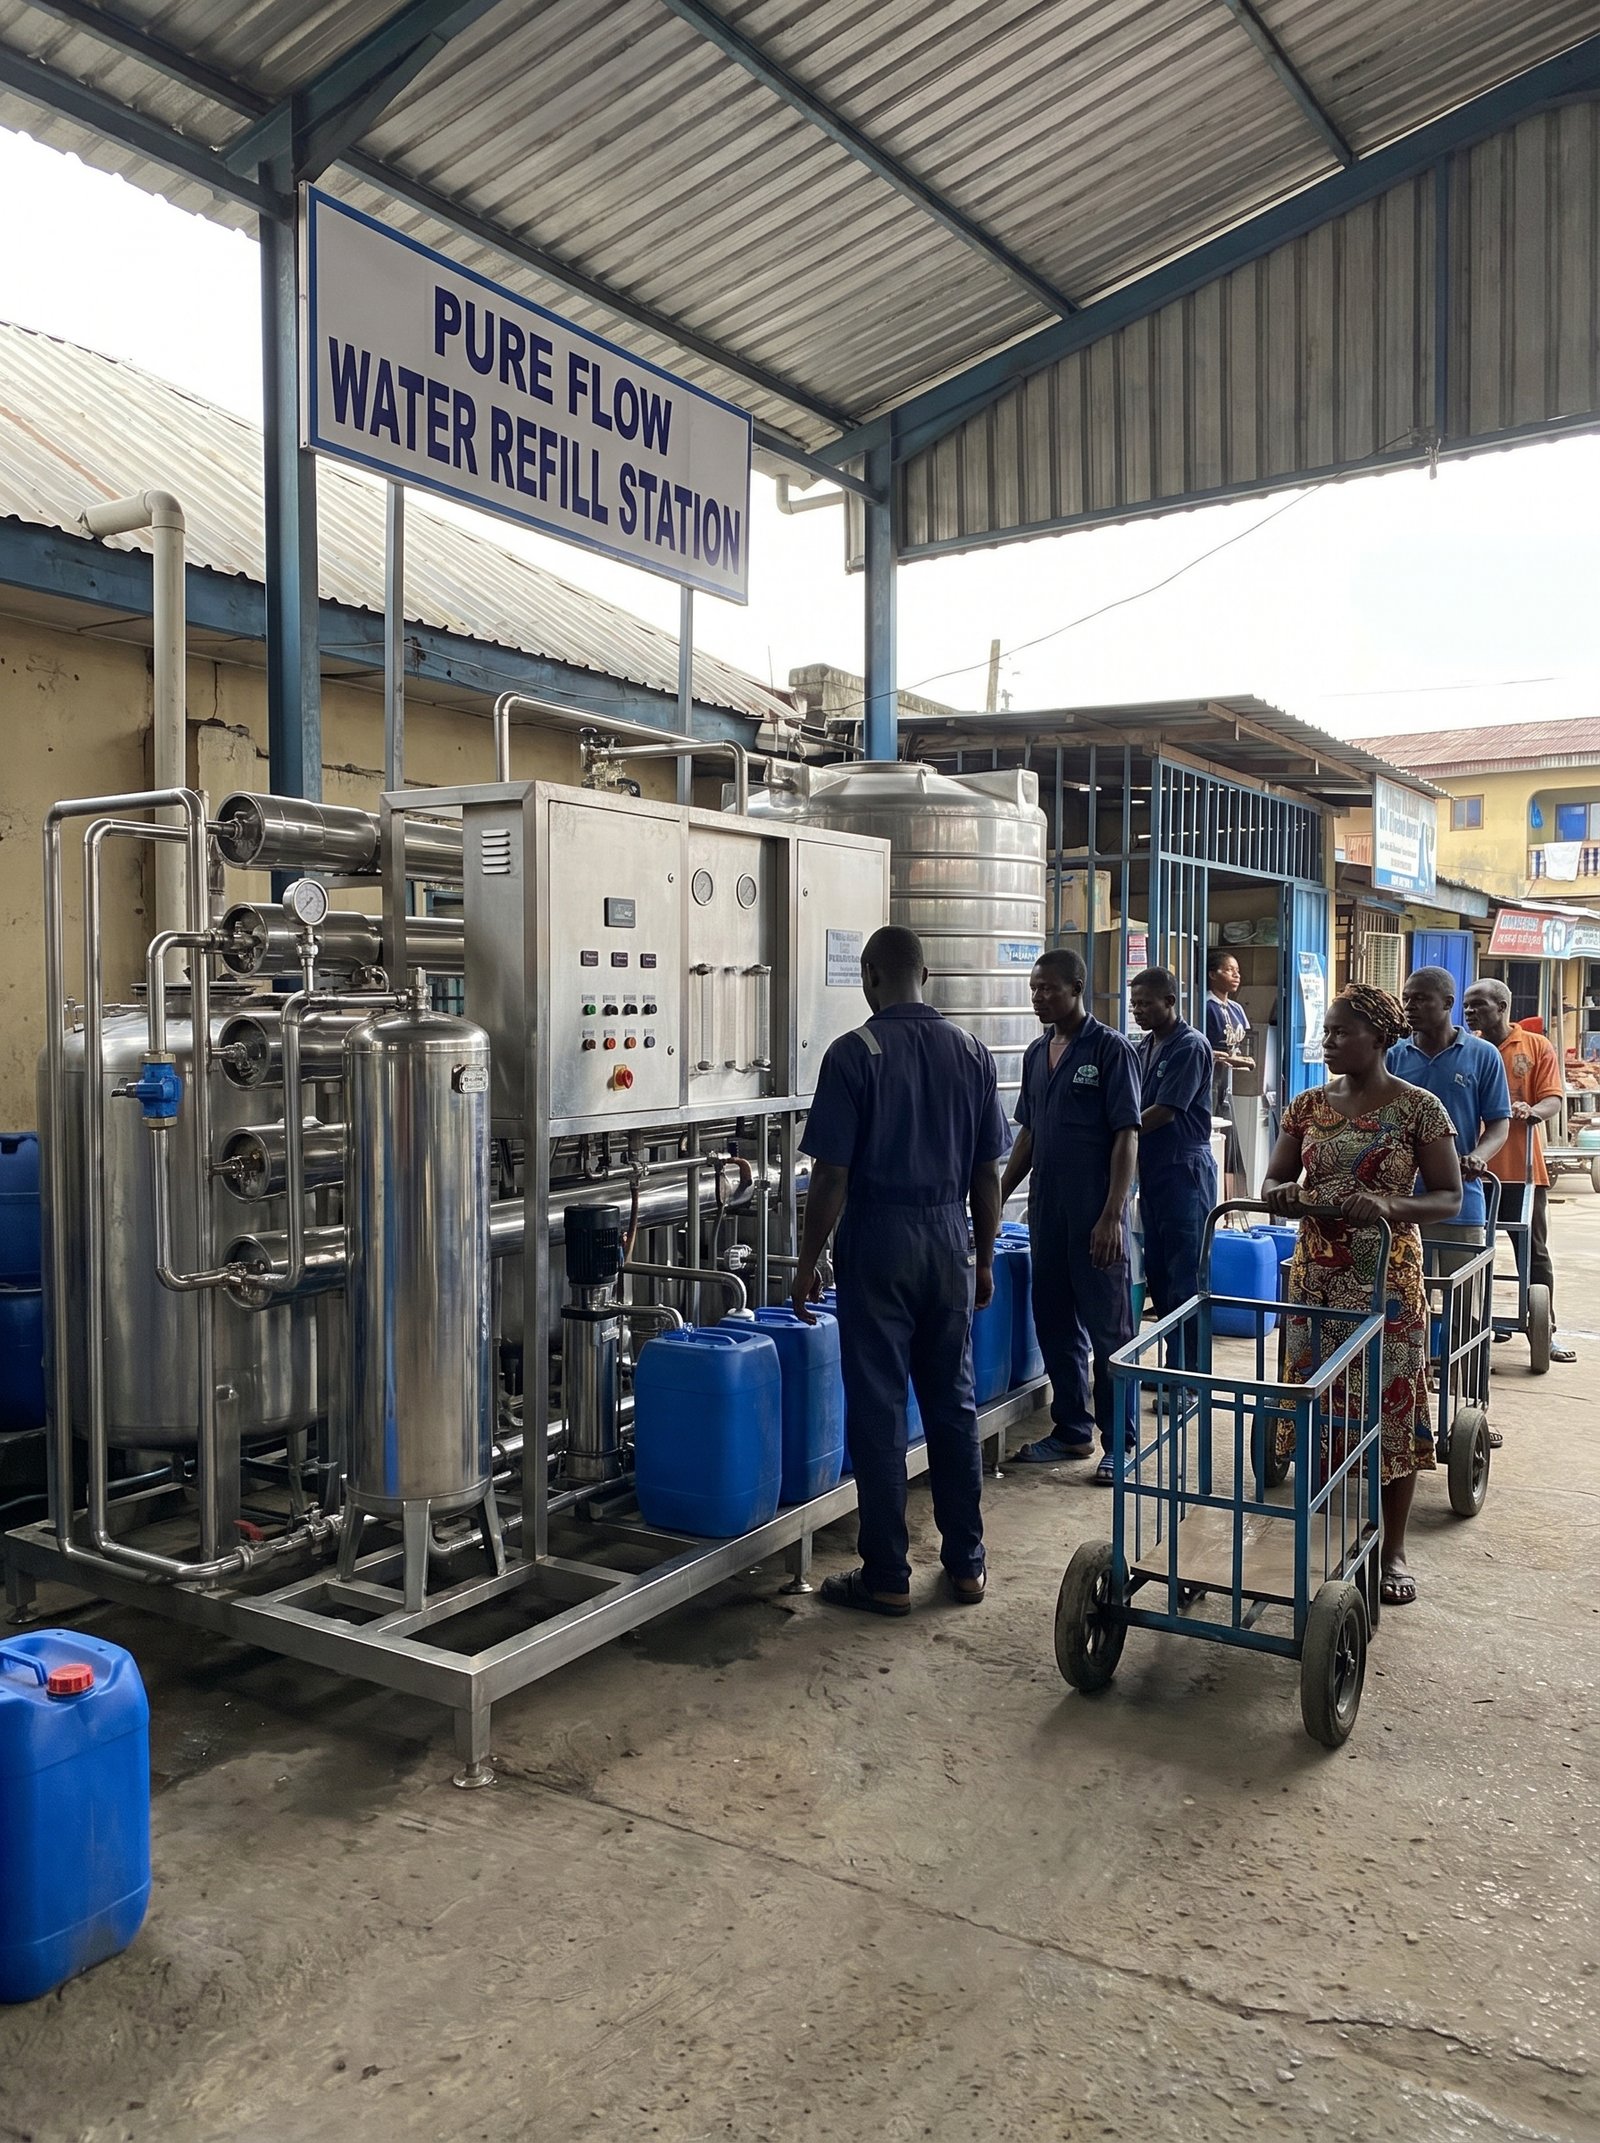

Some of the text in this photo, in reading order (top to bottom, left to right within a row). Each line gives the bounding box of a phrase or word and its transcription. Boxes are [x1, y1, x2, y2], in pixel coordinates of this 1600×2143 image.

[328, 336, 740, 576] WATER REFILL STATION
[435, 285, 672, 457] PURE FLOW
